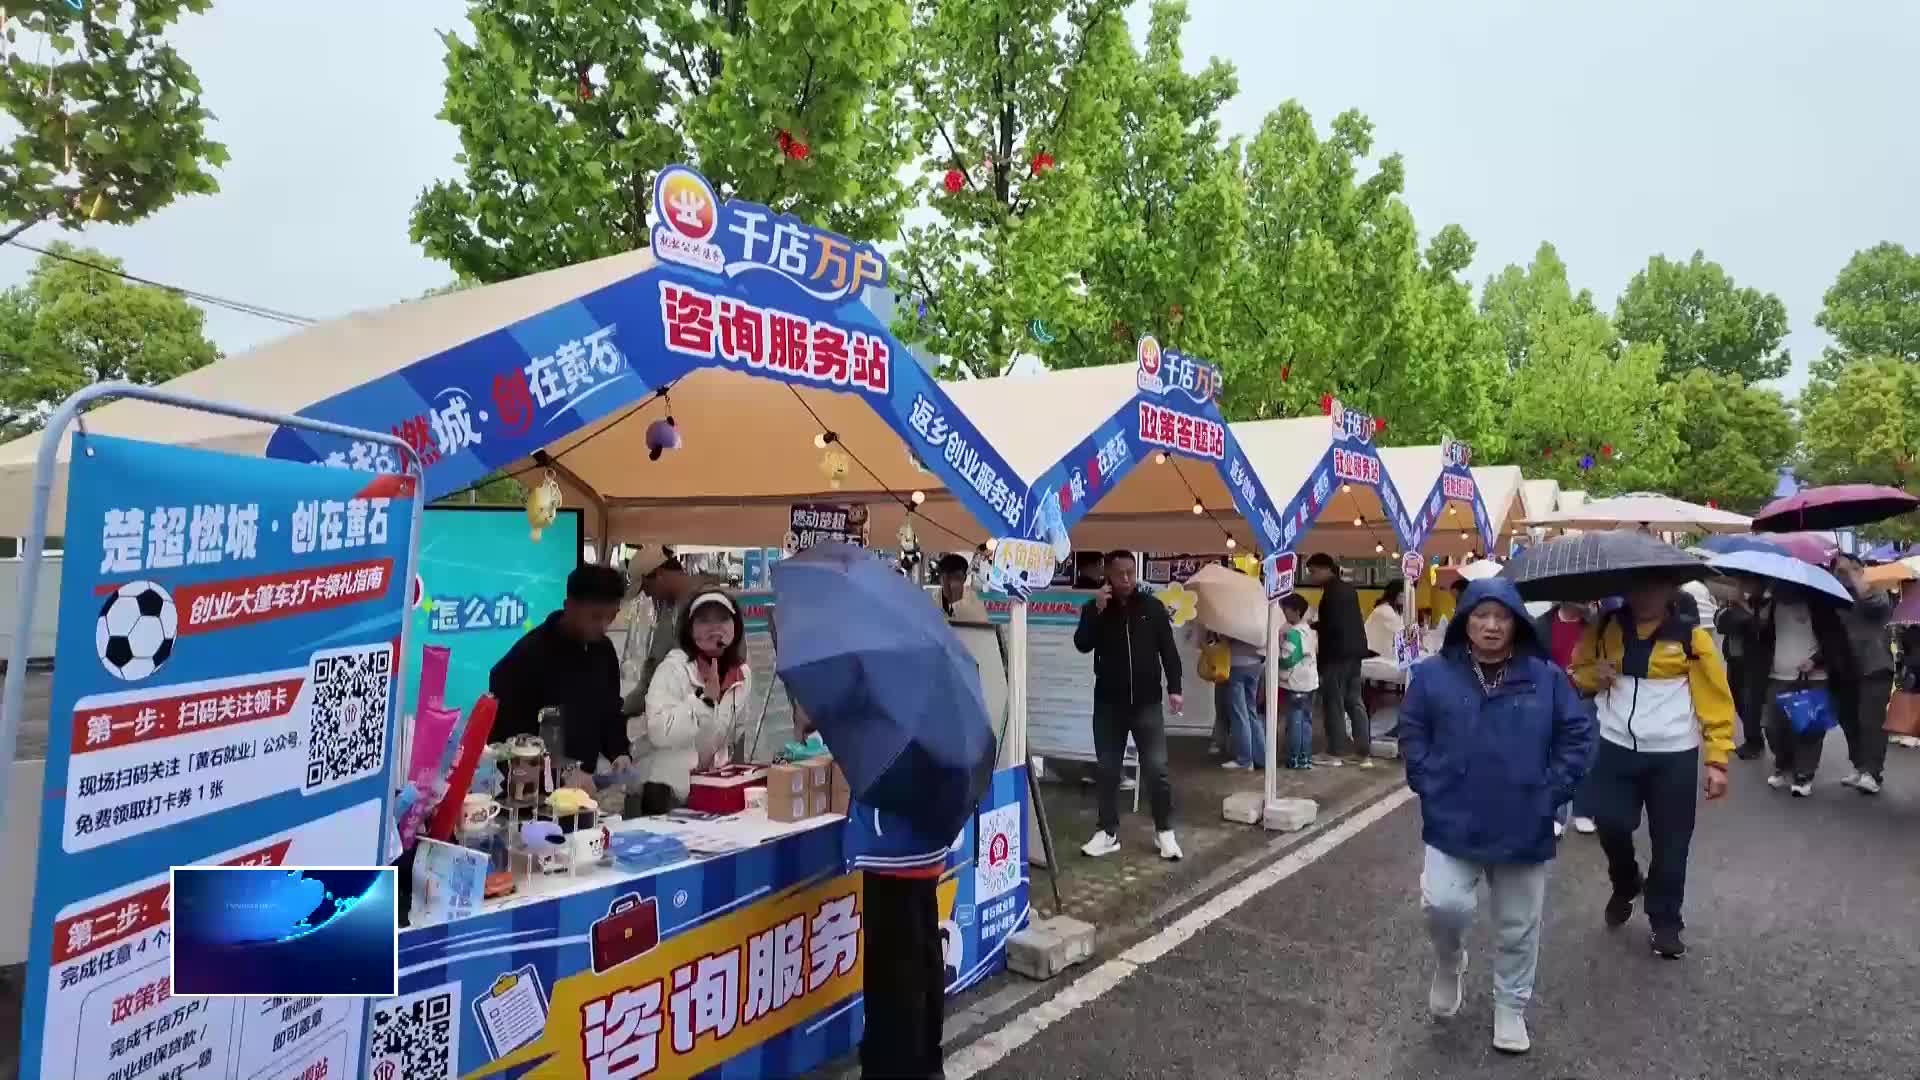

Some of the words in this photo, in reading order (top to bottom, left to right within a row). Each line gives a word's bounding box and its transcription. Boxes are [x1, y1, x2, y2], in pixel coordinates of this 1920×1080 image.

[728, 209, 883, 294] 千店万户
[661, 284, 889, 392] 咨询服务站
[1163, 354, 1222, 397] 千店万户
[1140, 402, 1224, 458] 政策答题站
[909, 394, 1024, 527] 返乡创业服务站
[431, 594, 525, 631] 怎么办
[75, 789, 192, 837] 免费领取打卡券
[209, 780, 224, 799] 张
[60, 943, 132, 990] 完成任意
[581, 893, 863, 1080] 咨询服务
